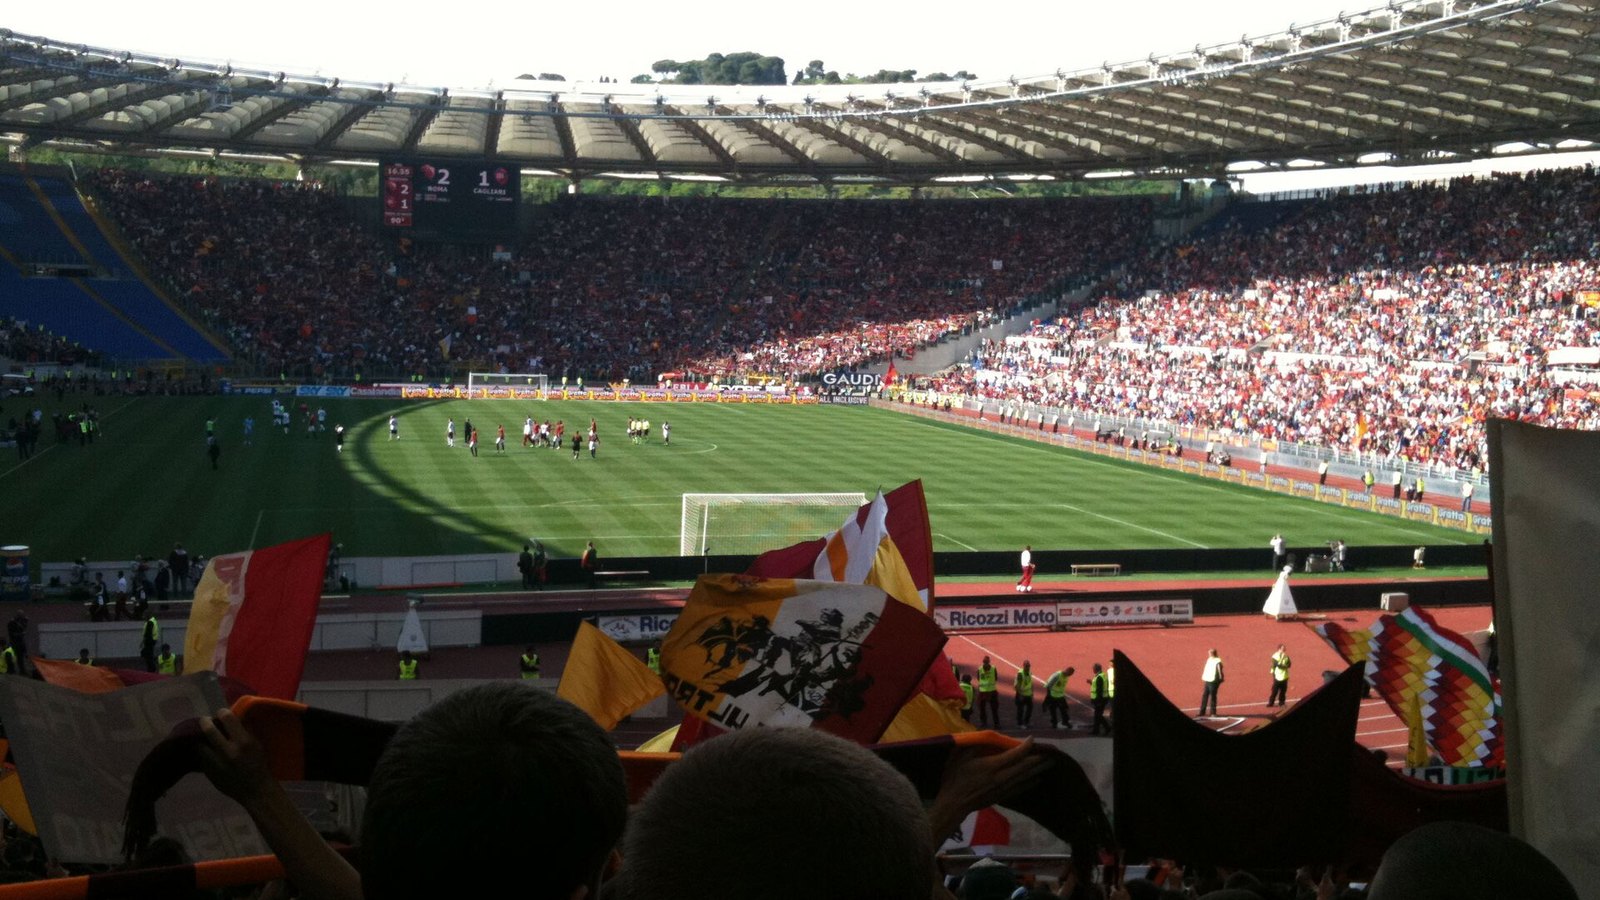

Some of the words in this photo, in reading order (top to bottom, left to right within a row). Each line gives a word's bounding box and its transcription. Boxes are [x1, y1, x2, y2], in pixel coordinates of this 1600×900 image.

[438, 169, 450, 185] 2
[479, 171, 490, 187] 1
[401, 185, 409, 194] 2
[401, 200, 408, 209] 1
[300, 387, 321, 396] SKY
[325, 387, 348, 396] SKY
[1407, 502, 1432, 514] Gratta
[1439, 508, 1466, 521] Gratta
[950, 610, 1009, 626] Ricozzi
[1013, 608, 1055, 625] Moto
